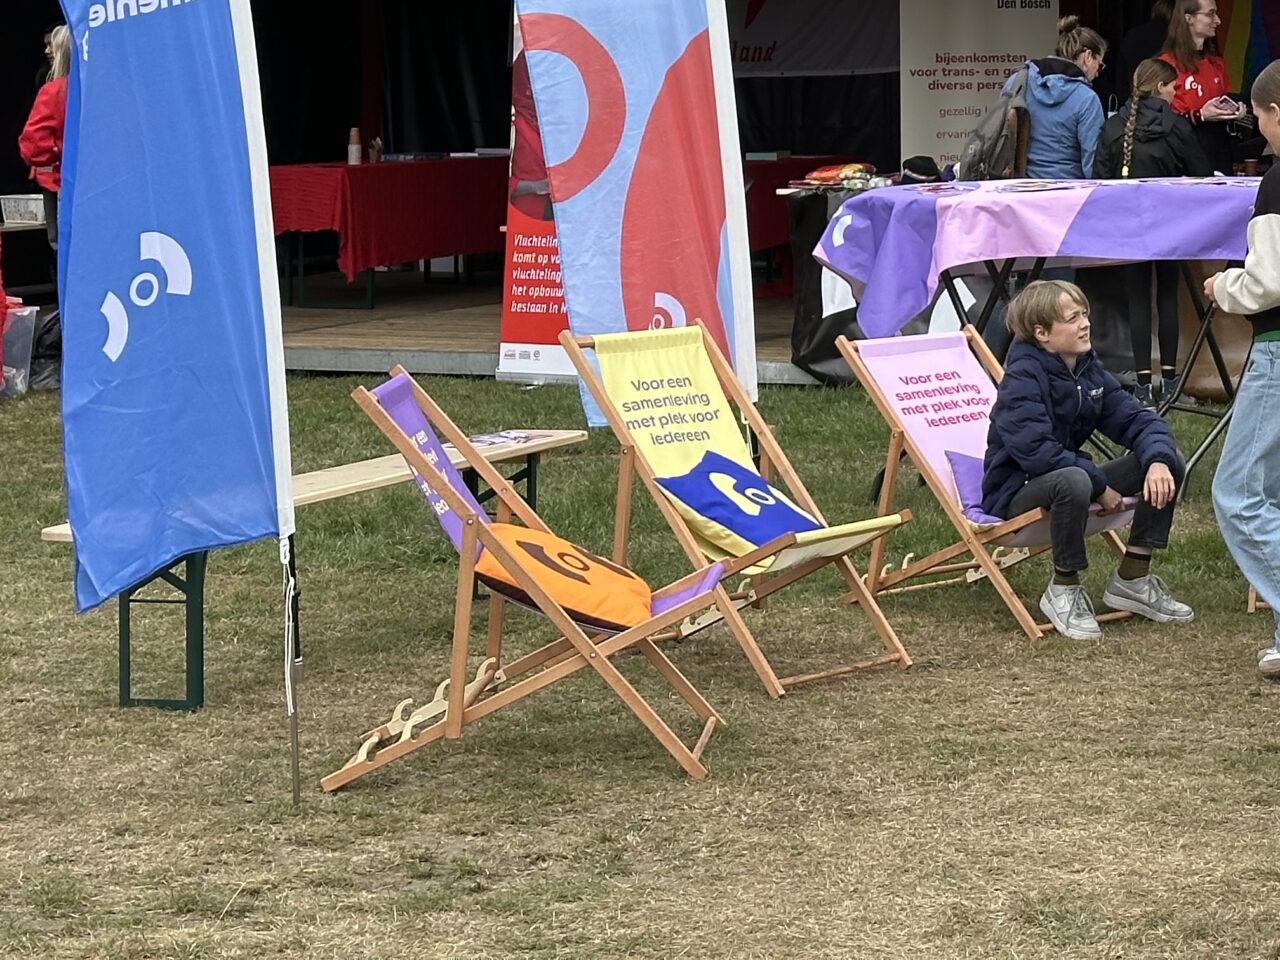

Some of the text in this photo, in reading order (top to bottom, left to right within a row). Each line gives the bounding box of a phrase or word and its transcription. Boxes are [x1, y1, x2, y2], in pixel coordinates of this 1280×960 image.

[935, 53, 1027, 66] bijeenkomsten
[910, 67, 938, 78] voor
[942, 66, 980, 78] trans-
[984, 68, 999, 78] en
[928, 80, 1004, 92] diverse pers
[939, 106, 982, 119] gezellig
[513, 234, 558, 248] Vluchtelin
[512, 251, 536, 264] komt
[537, 253, 548, 266] op
[512, 268, 562, 283] vluchteling
[511, 285, 564, 301] het opbouw
[510, 302, 546, 313] bestaan
[549, 302, 558, 314] in
[630, 376, 692, 392] Voor een
[898, 370, 962, 386] Voor een
[895, 383, 981, 401] samenleving
[622, 393, 710, 413] samenleving
[900, 397, 991, 416] met plek voor
[626, 408, 720, 431] met plek voor
[924, 410, 988, 428] iedereen
[649, 430, 710, 446] iedereen
